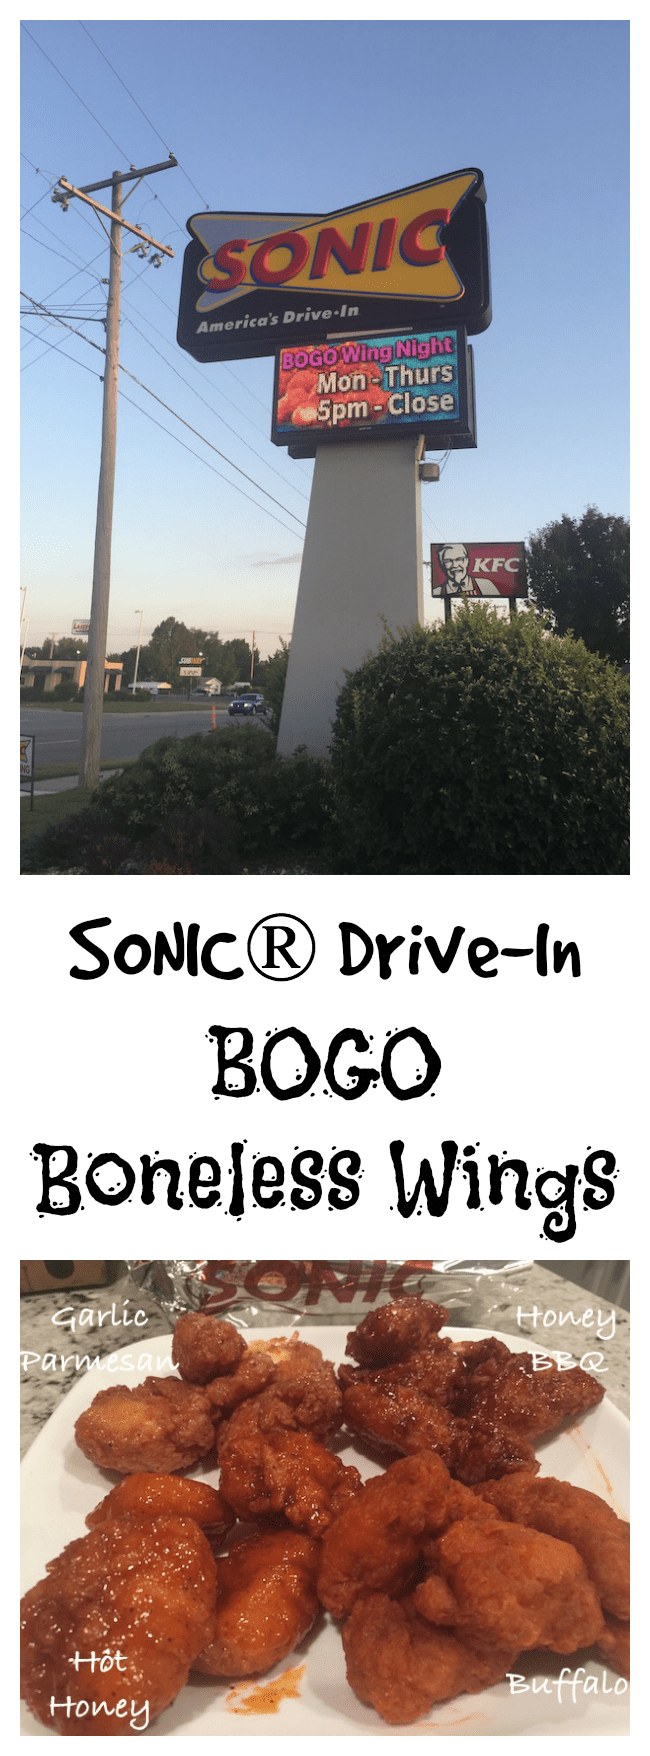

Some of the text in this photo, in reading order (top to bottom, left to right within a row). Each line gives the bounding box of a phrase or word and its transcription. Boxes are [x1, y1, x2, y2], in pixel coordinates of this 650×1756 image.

[205, 208, 451, 292] SONIC
[195, 313, 279, 334] America's
[281, 337, 453, 370] BOGO Wing Night
[316, 371, 366, 395] Mon
[384, 364, 453, 388] Thurs
[317, 399, 368, 425] 5pm
[388, 391, 454, 416] Close
[472, 557, 520, 573] KFC
[201, 1260, 434, 1314] SONIC
